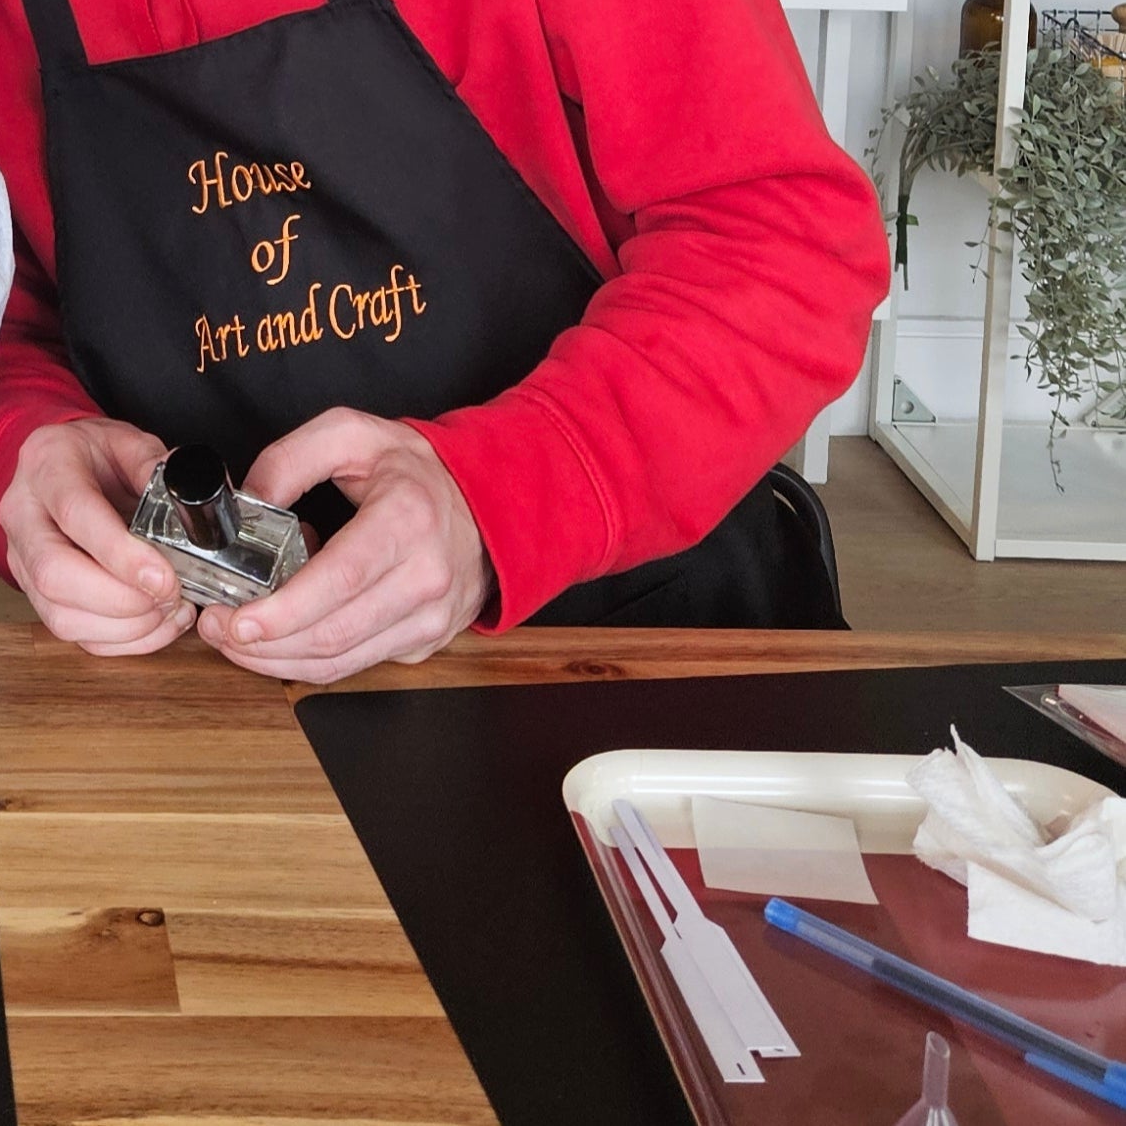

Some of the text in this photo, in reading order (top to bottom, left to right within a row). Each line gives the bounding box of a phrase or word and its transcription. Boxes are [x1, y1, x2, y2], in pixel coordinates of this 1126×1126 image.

[188, 151, 311, 214] House
[251, 214, 301, 285] of
[195, 264, 427, 373] Art and Craft
